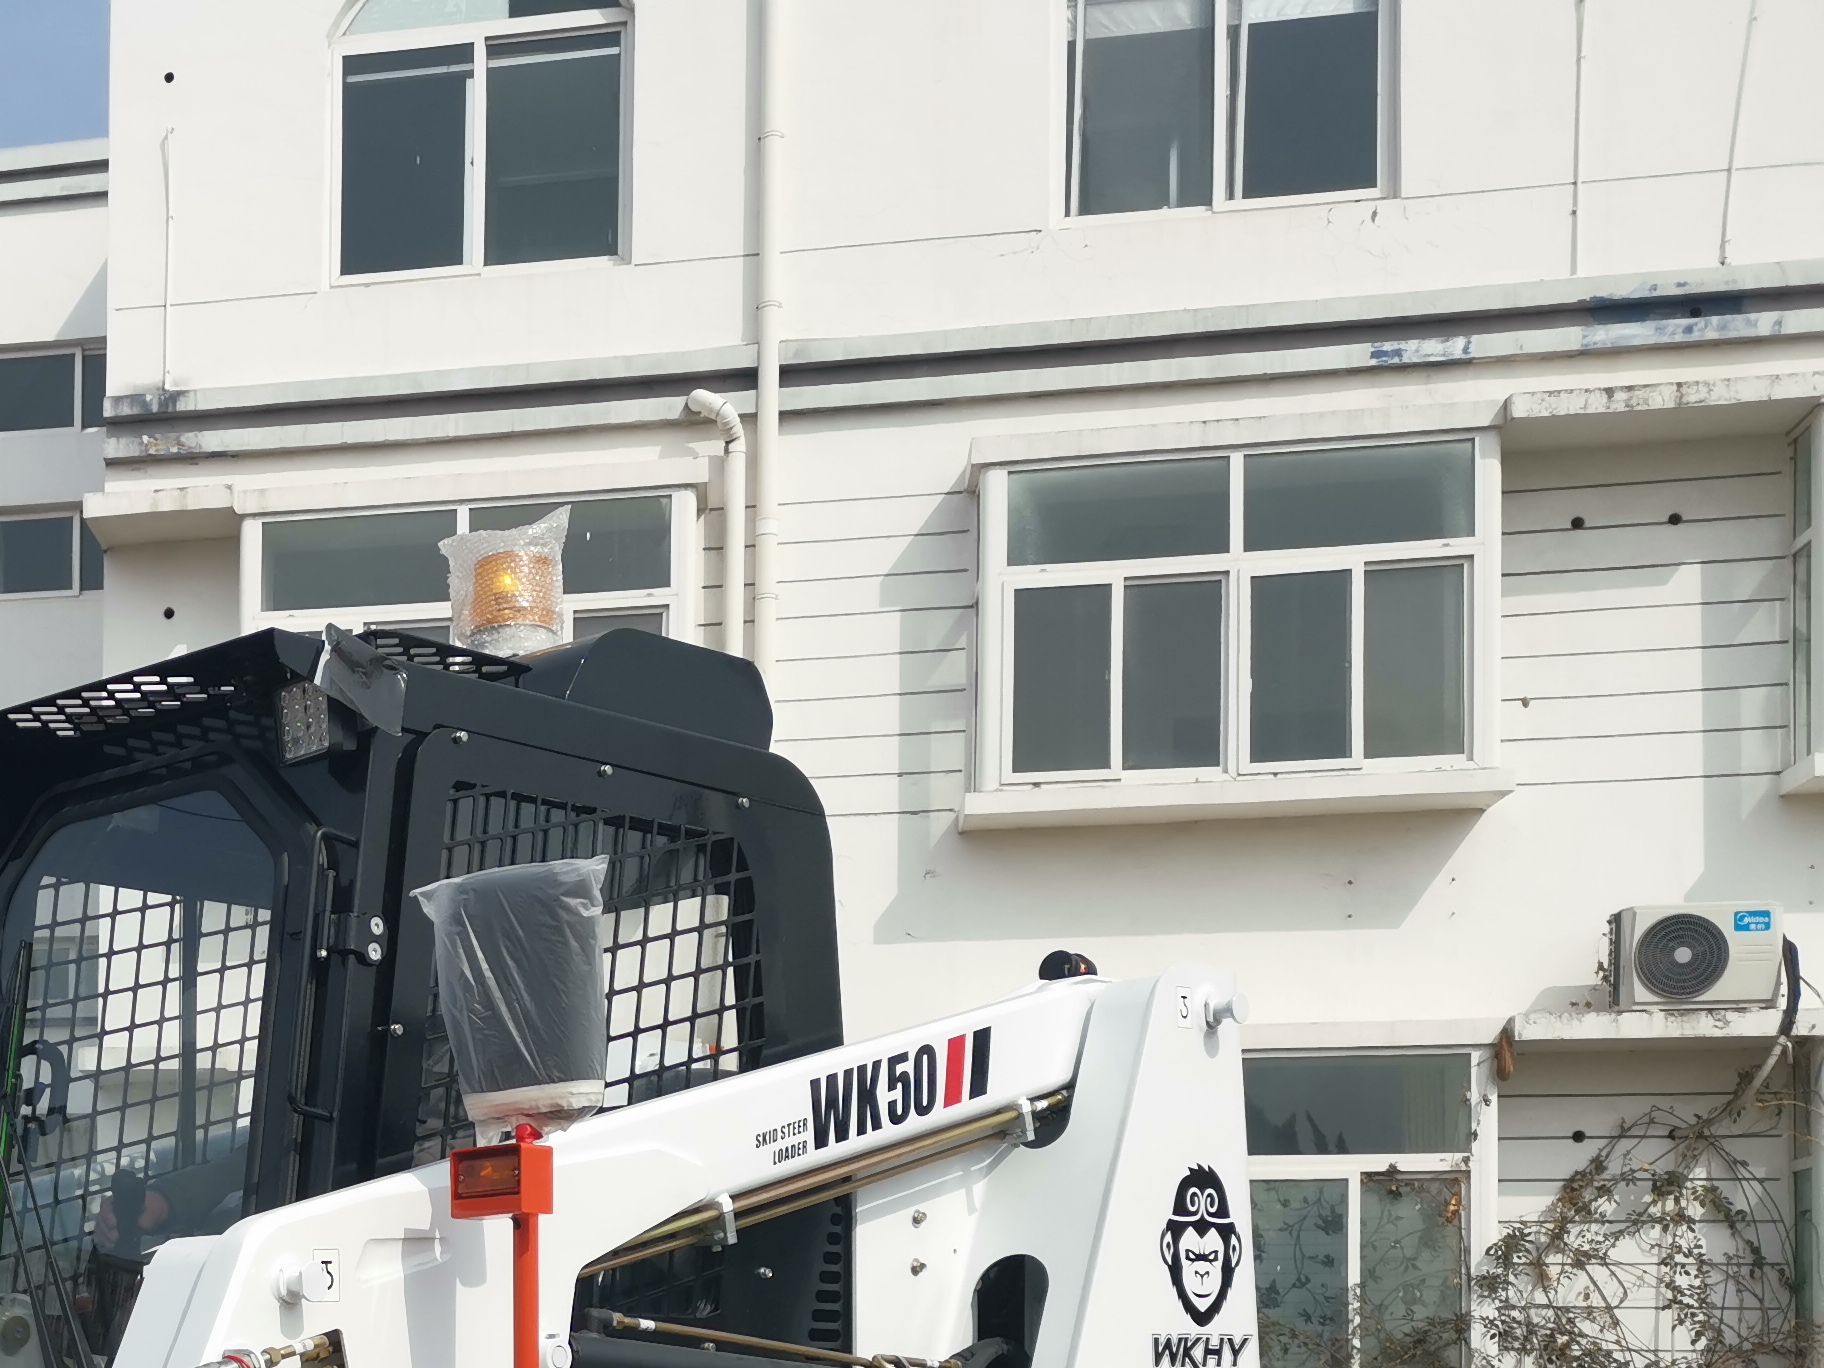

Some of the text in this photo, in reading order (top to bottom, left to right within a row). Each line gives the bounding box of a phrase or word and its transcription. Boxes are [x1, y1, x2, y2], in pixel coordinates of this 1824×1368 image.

[809, 1043, 937, 1151] WK50
[755, 1117, 808, 1149] SKID STEER
[772, 1140, 808, 1166] LOADER
